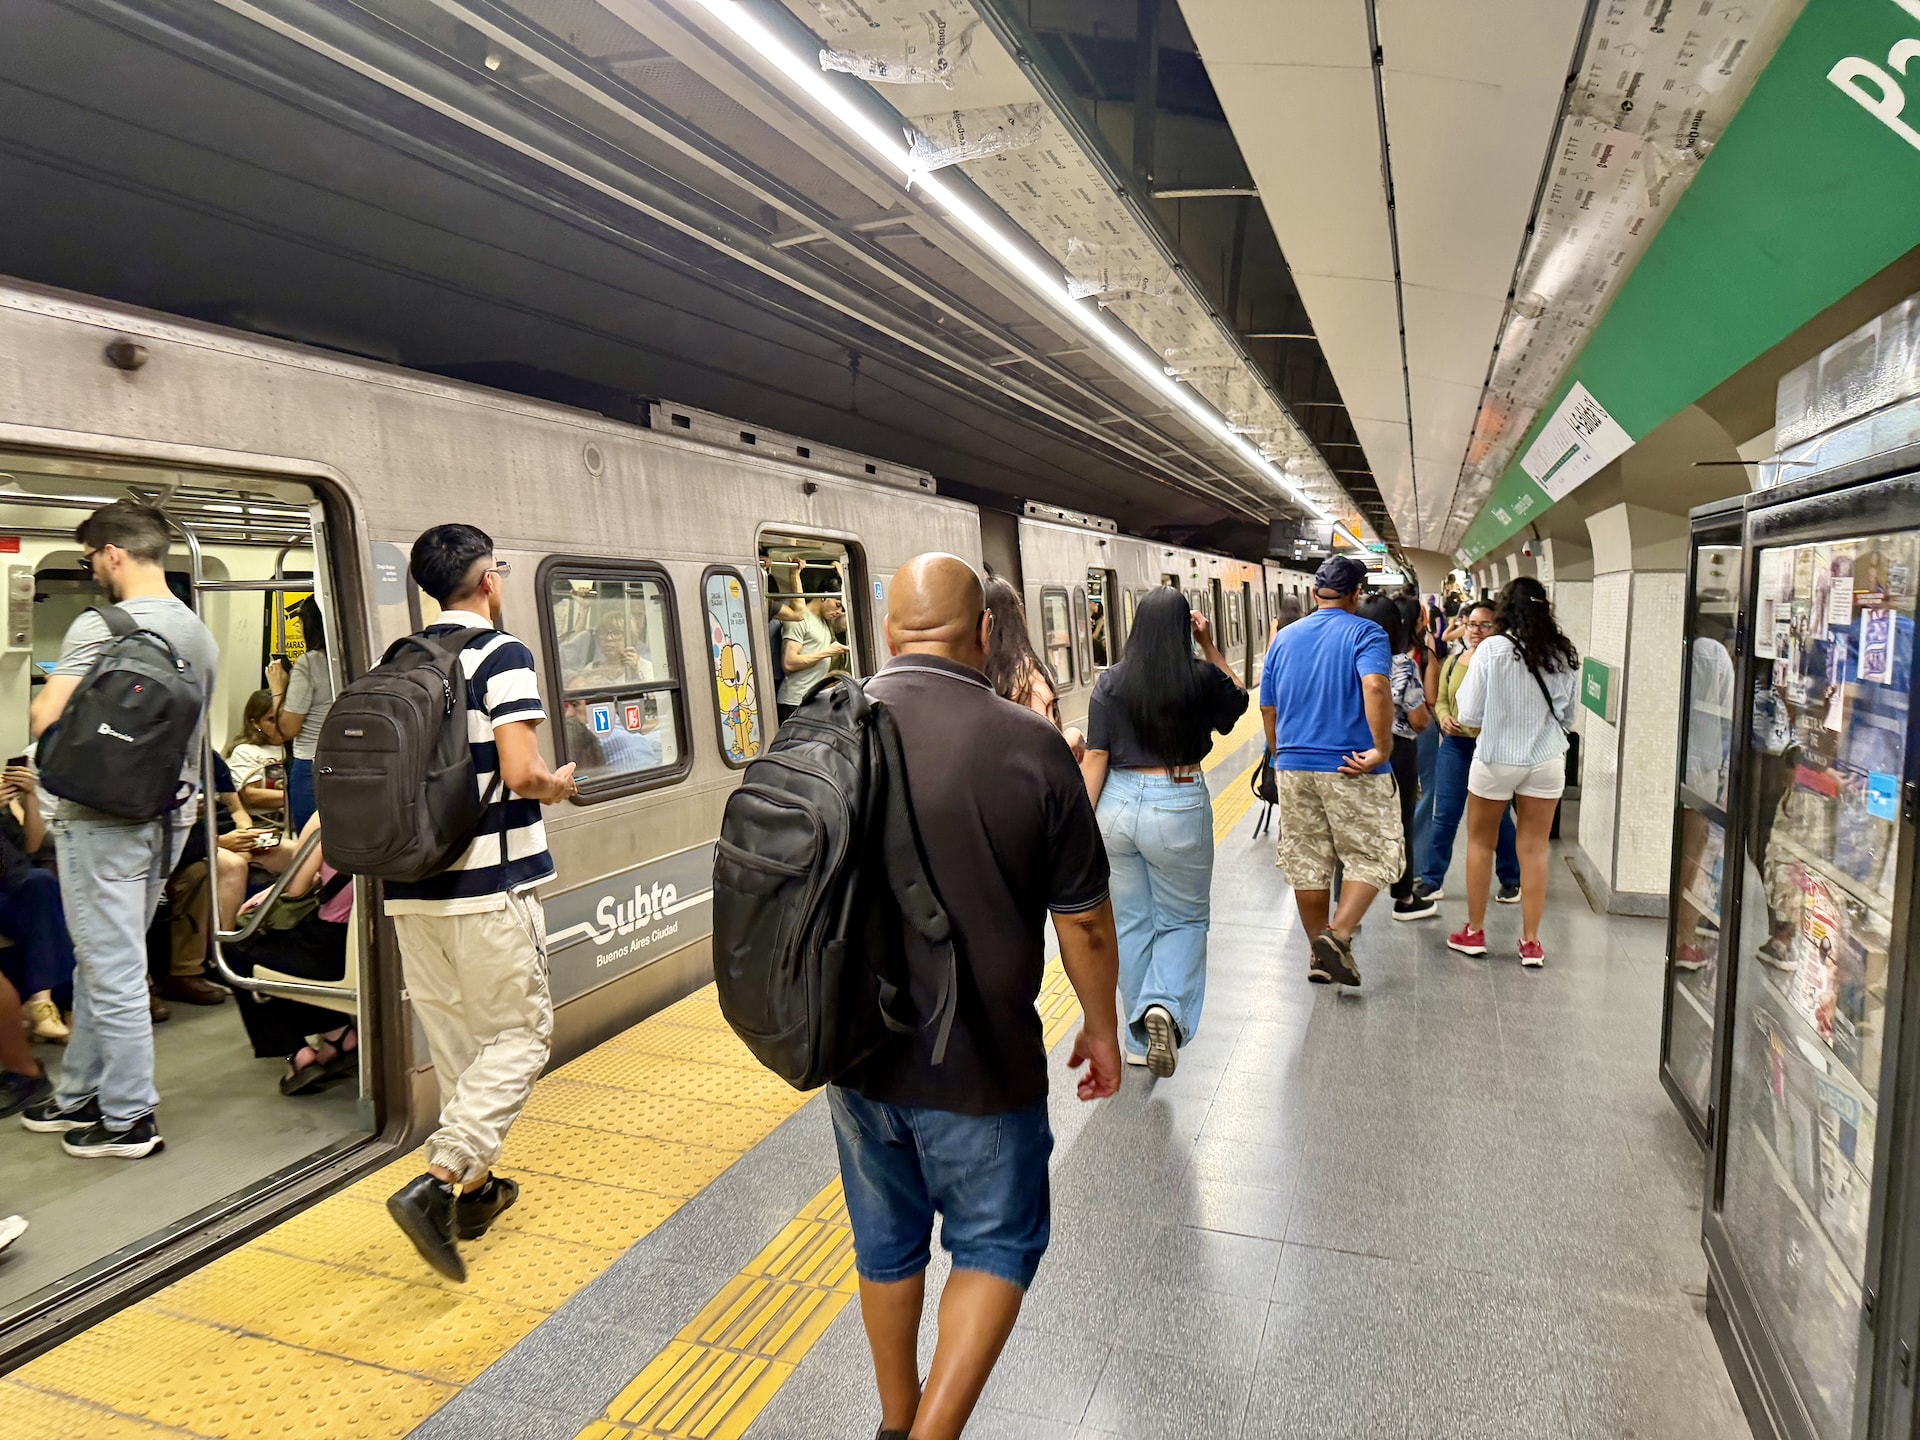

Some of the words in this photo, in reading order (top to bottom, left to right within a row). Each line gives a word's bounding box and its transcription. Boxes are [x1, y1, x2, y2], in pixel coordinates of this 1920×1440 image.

[1571, 402, 1601, 434] Salida
[593, 881, 678, 945] Subte
[596, 945, 629, 968] Buenos
[630, 938, 651, 953] Aires
[651, 921, 679, 942] Ciudad
